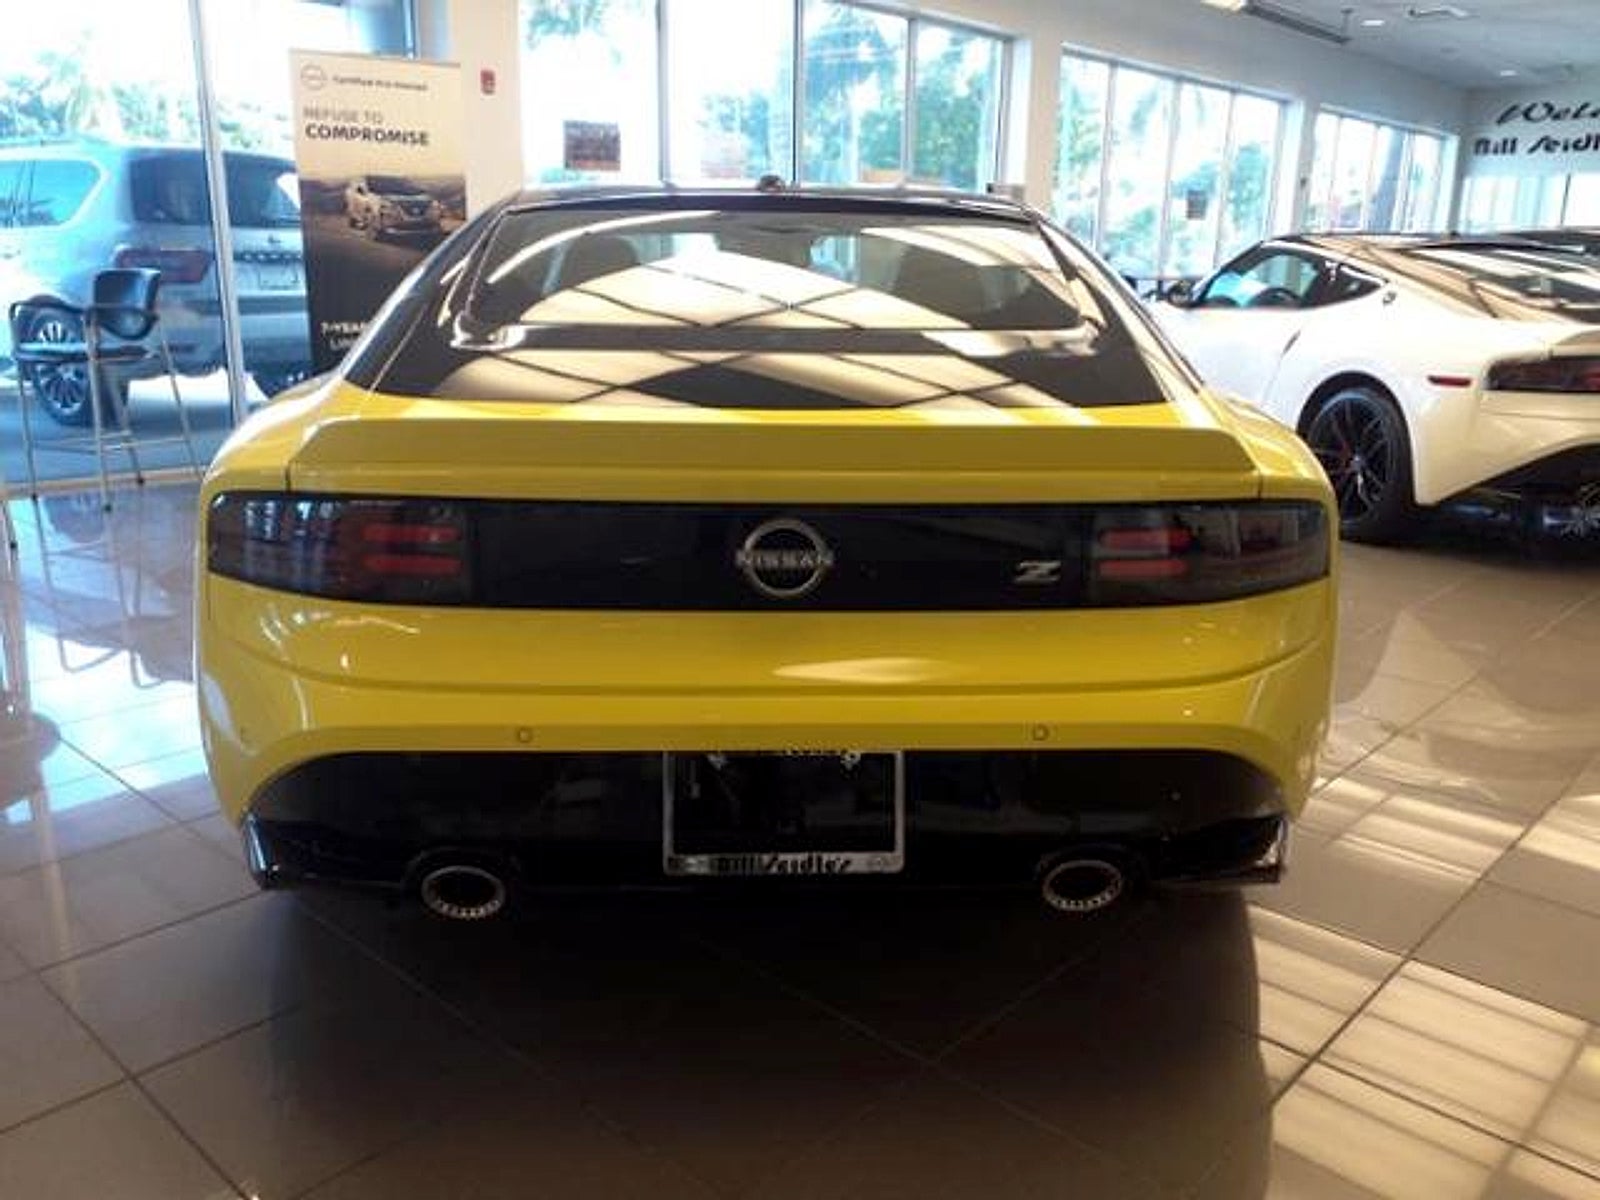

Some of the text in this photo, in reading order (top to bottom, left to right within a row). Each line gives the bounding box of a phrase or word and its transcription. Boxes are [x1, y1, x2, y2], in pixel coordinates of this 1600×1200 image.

[303, 107, 383, 123] REFUSE TO
[305, 124, 430, 146] COMPROMISE
[1474, 137, 1518, 155] Bill
[1016, 560, 1060, 584] Z
